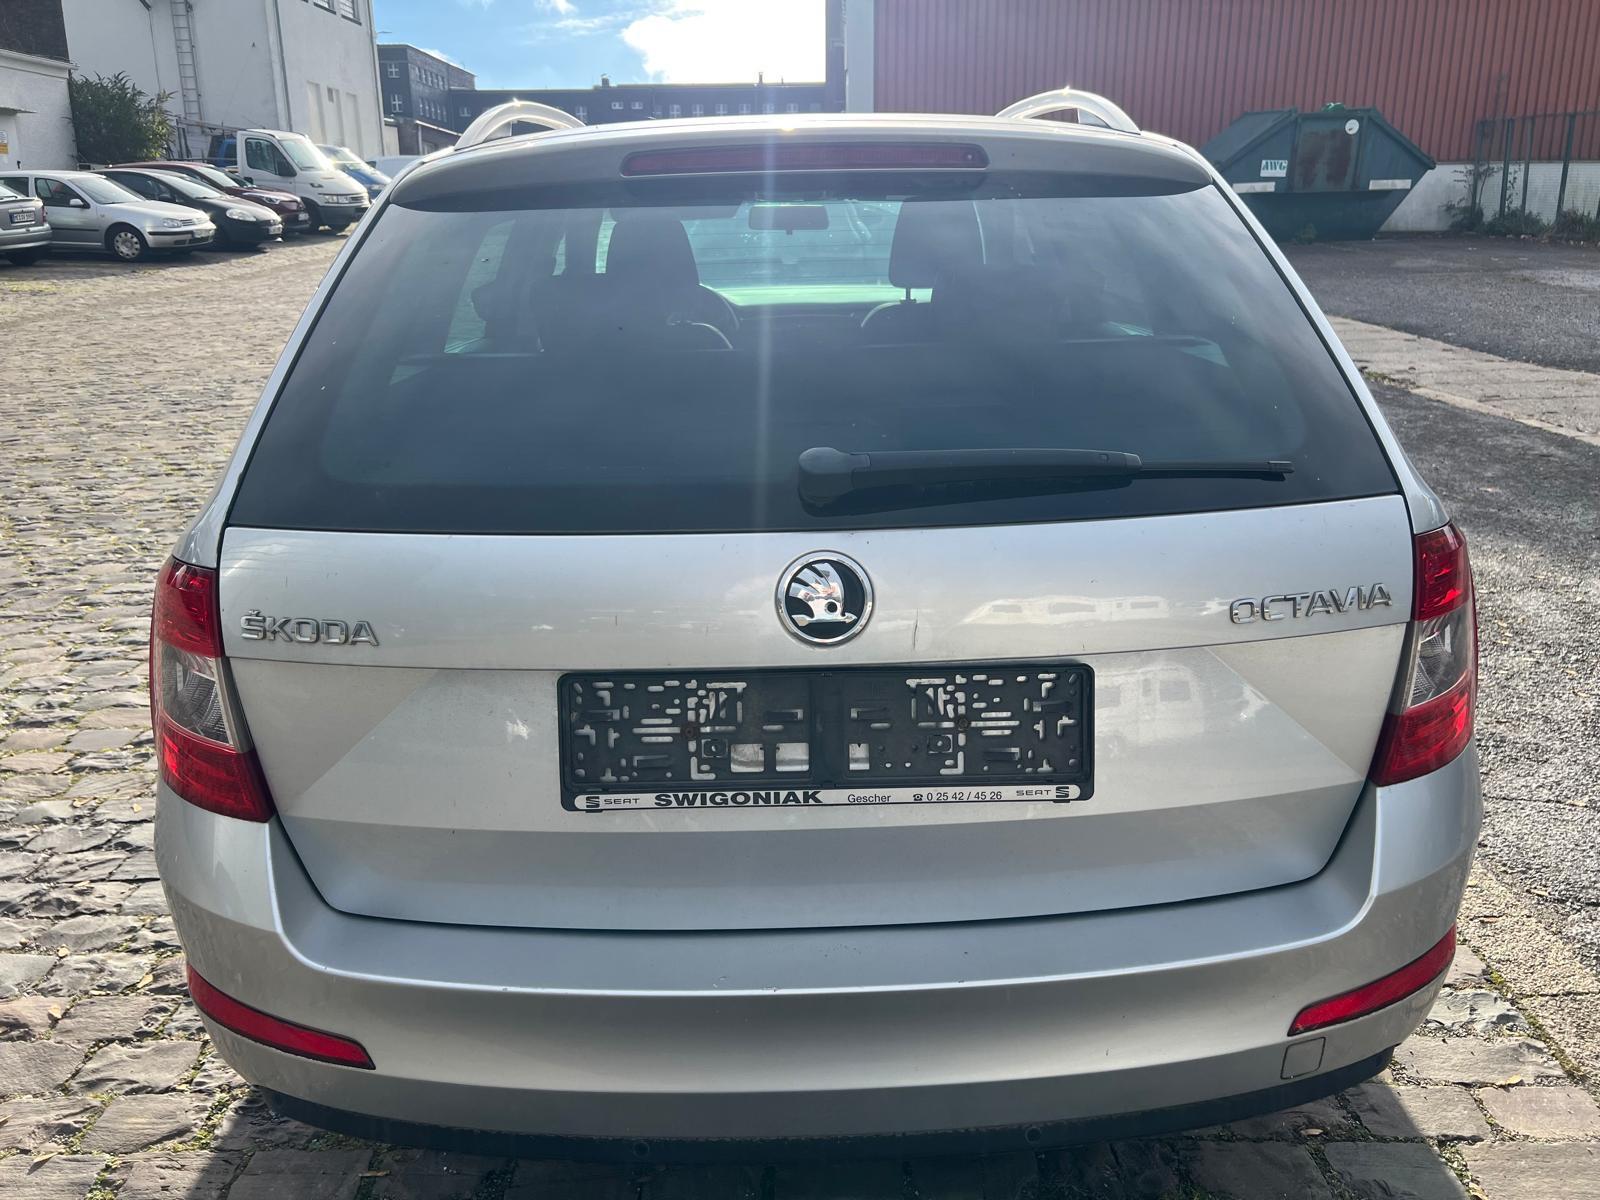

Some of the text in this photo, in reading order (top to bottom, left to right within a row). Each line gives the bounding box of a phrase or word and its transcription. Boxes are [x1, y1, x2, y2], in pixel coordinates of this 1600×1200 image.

[1262, 160, 1287, 171] AWG
[1230, 583, 1393, 624] OCTAVIA
[241, 609, 379, 646] ŠKODA
[603, 797, 640, 806] SEAT
[654, 791, 823, 807] SWIGONIAK
[847, 793, 892, 804] Gescher
[926, 792, 933, 802] 0
[934, 792, 949, 802] 25
[951, 792, 965, 801] 42
[974, 791, 988, 801] 45
[989, 791, 1003, 800] 26
[1016, 788, 1052, 797] SEAT
